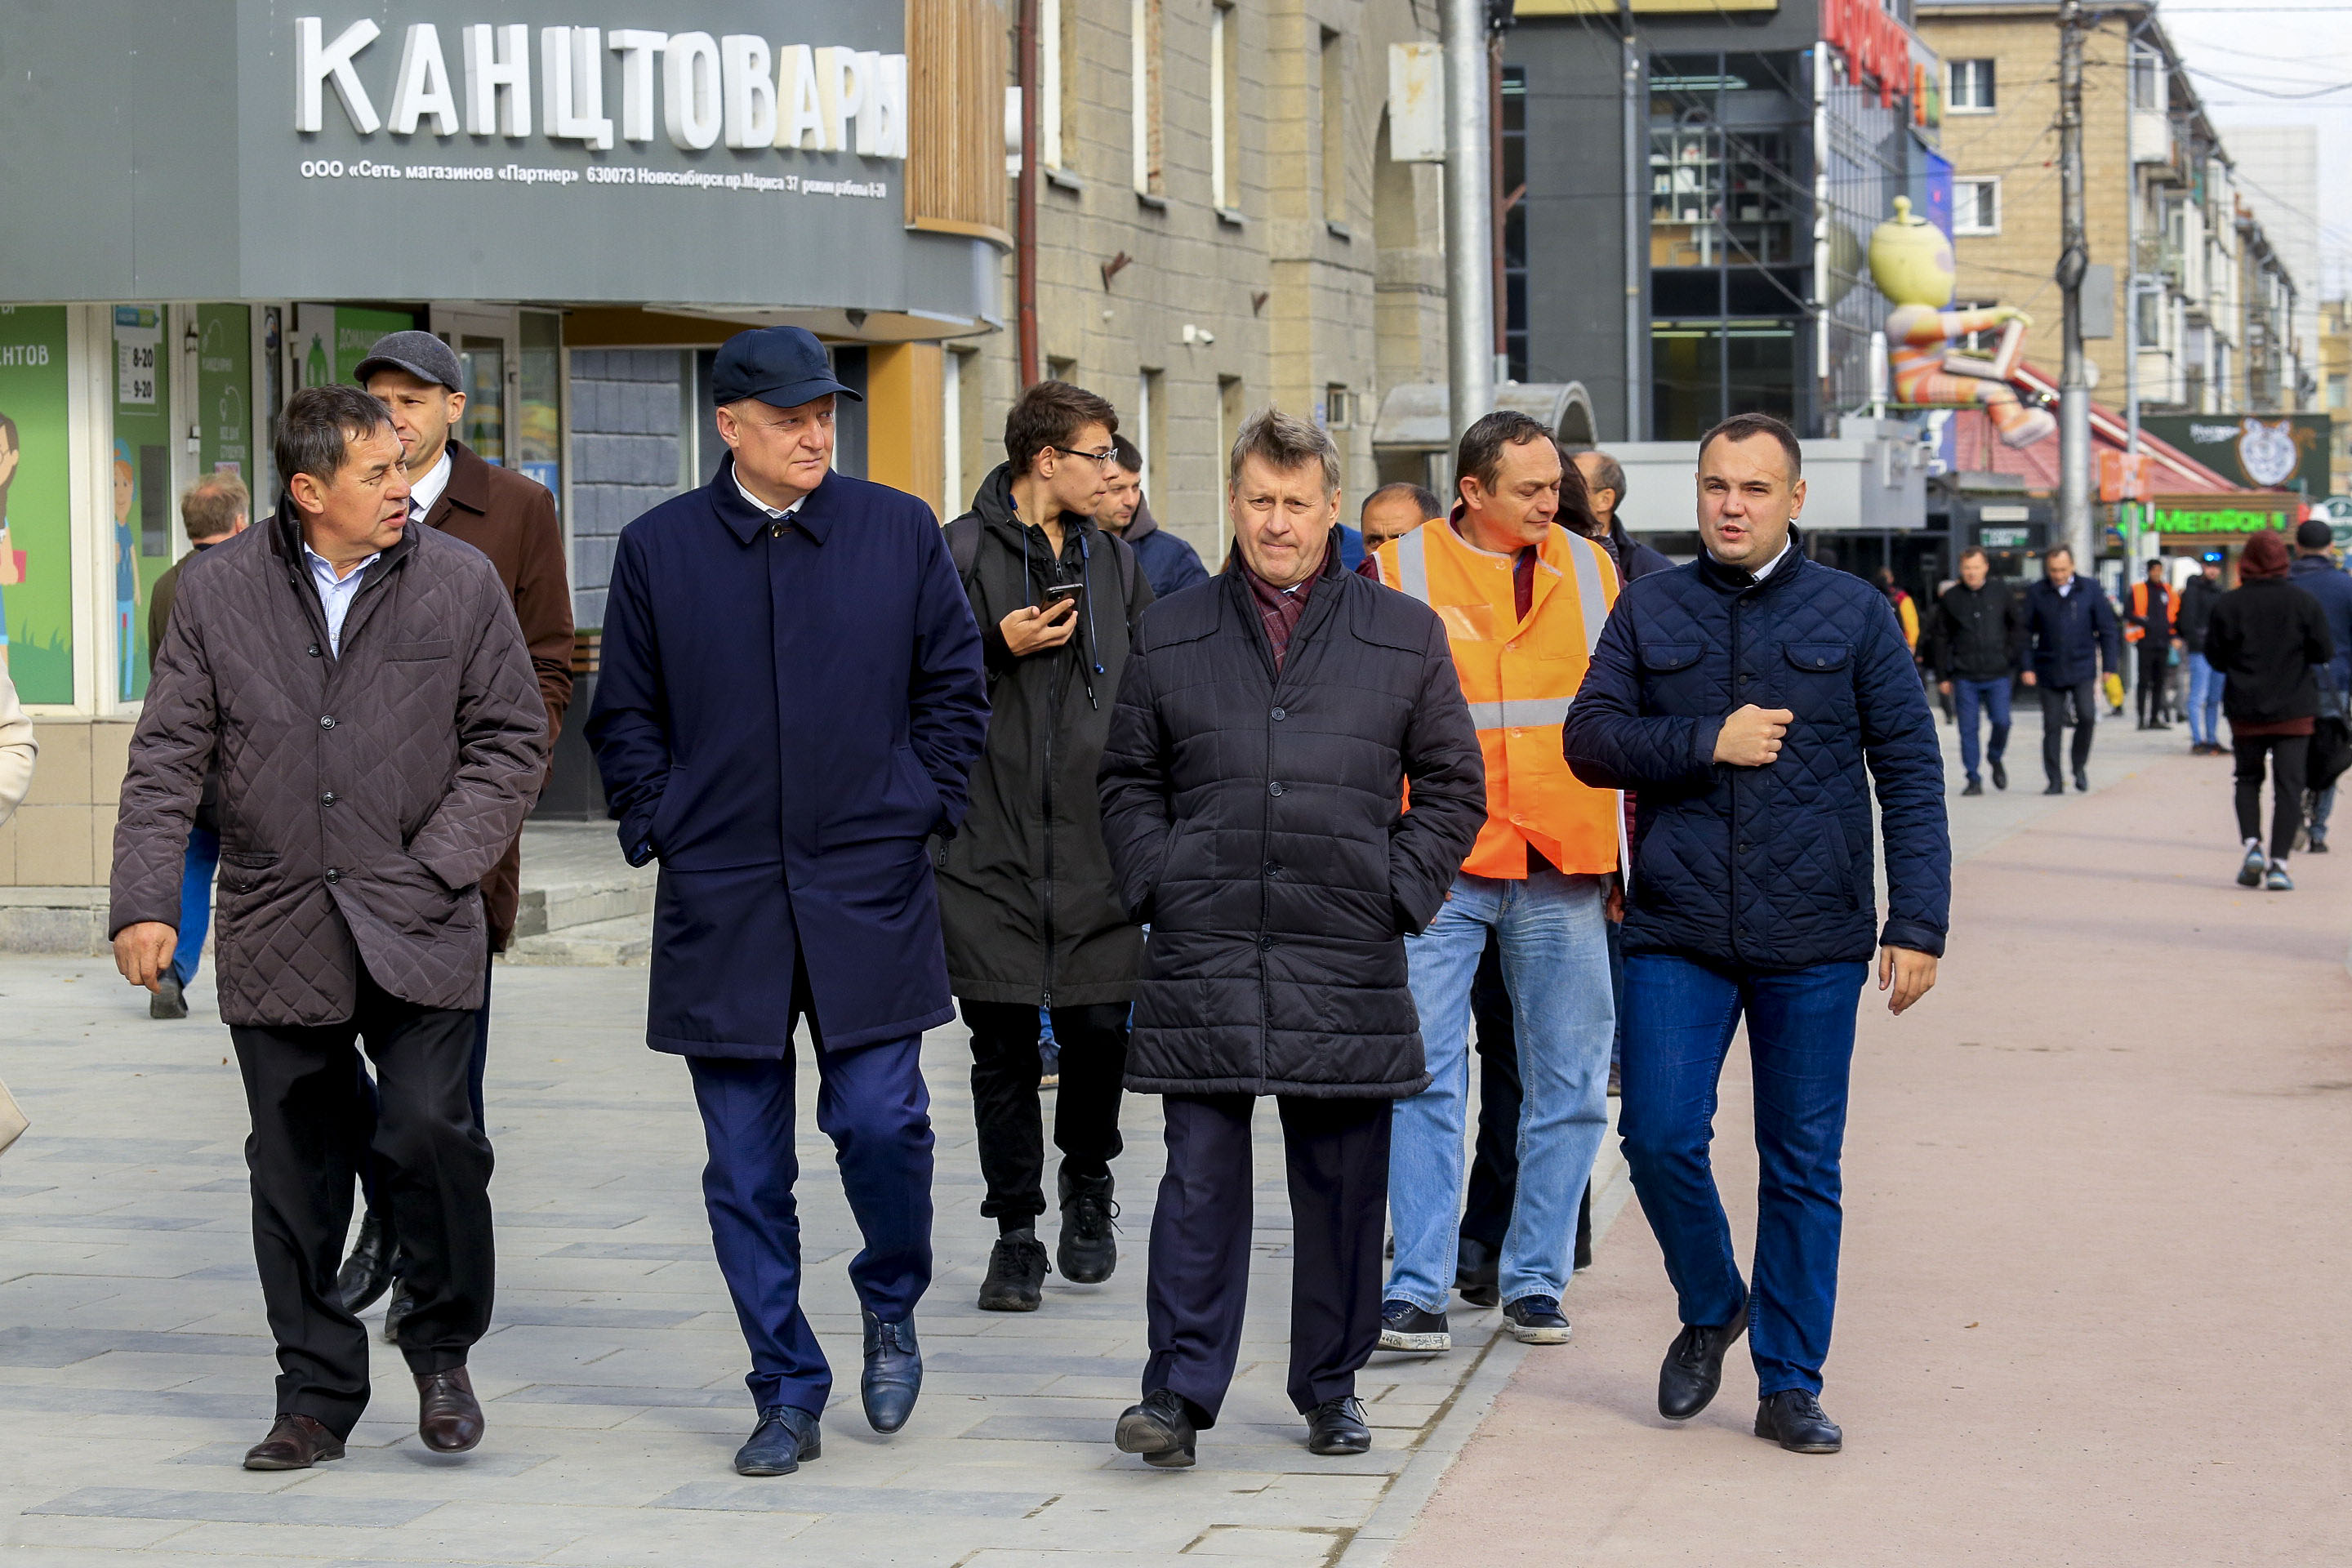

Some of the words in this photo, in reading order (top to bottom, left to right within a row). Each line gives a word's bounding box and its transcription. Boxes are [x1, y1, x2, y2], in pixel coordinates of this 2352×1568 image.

[295, 16, 907, 160] КАНЦТОВАРЫ
[301, 159, 344, 178] ООО
[349, 159, 402, 179] «Сеть
[406, 165, 495, 180] магазинов
[497, 163, 580, 186] «Партнер»
[586, 166, 636, 185] 630073
[638, 168, 724, 189] Новосибирск
[786, 174, 800, 192] 37
[0, 345, 49, 366] НТОВ
[132, 347, 154, 368] 8-20
[133, 380, 153, 399] 9-20
